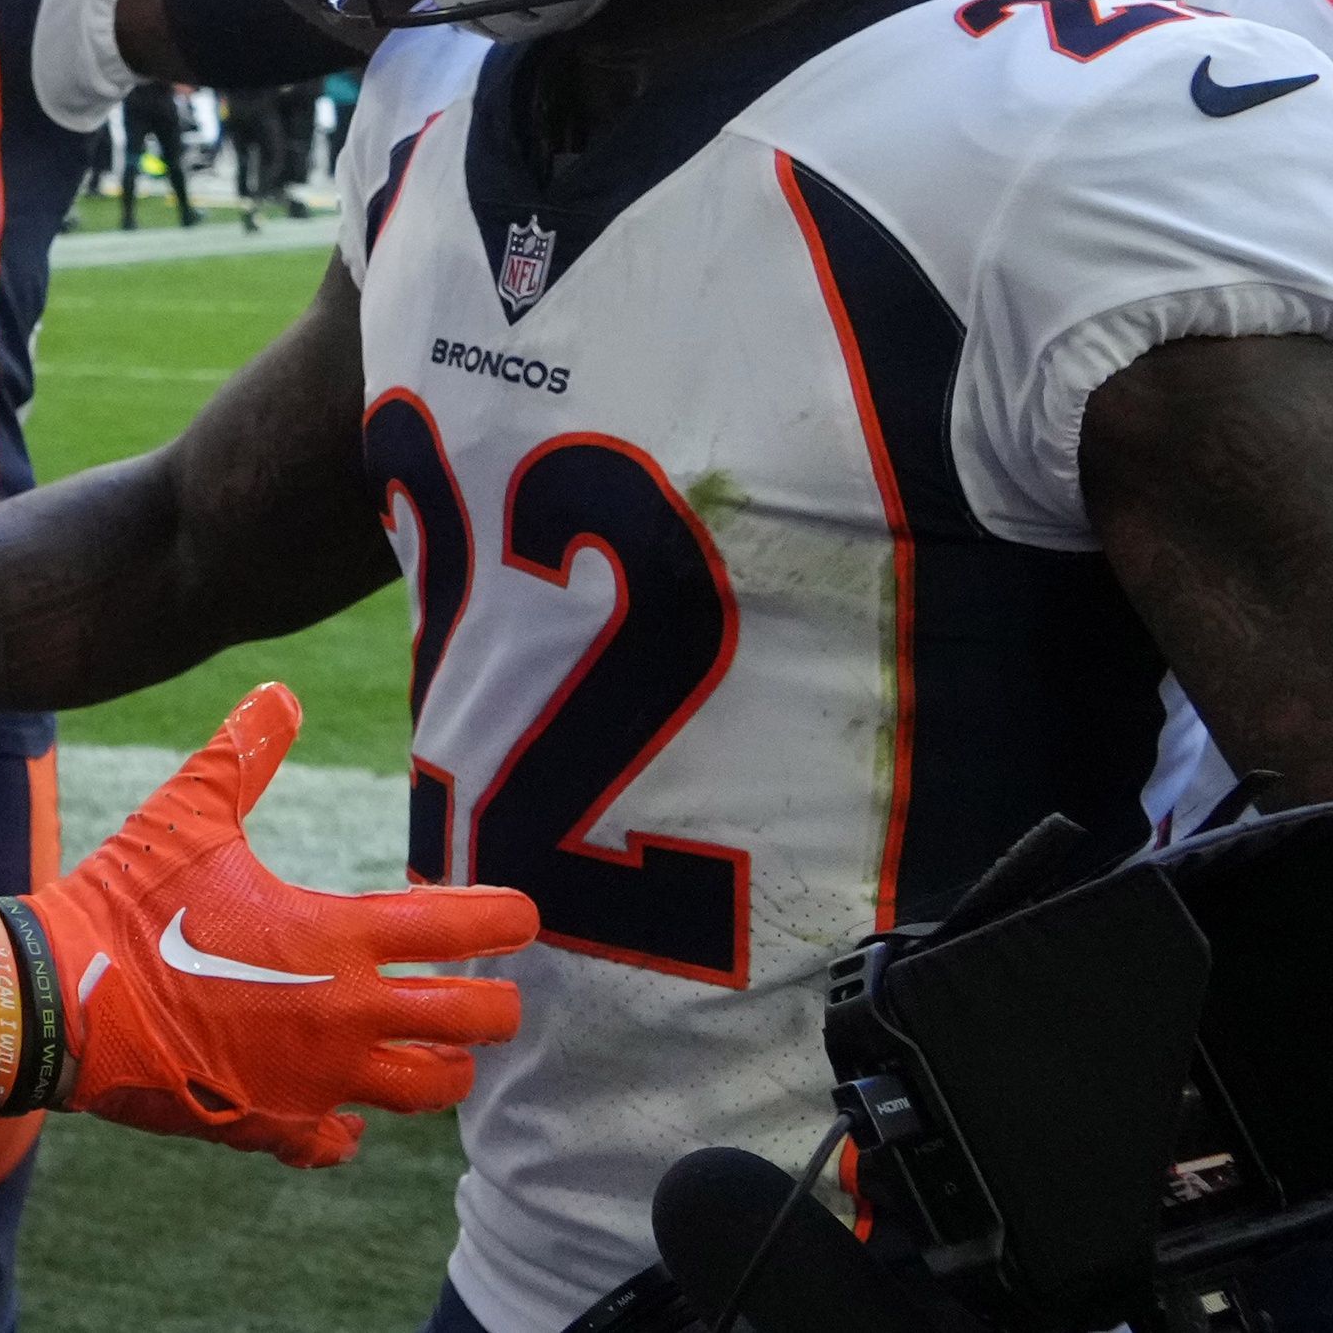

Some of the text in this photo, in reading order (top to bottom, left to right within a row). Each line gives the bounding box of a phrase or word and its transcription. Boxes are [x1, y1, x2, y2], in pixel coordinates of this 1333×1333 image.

[506, 257, 539, 294] NFL
[431, 338, 571, 394] BRONCOS
[363, 386, 751, 990] 22
[13, 916, 42, 955] AND
[33, 959, 54, 1003] NOT
[0, 1018, 18, 1030] I
[42, 1009, 56, 1039] BE
[875, 1096, 912, 1115] HDMI
[616, 1289, 637, 1308] MAX
